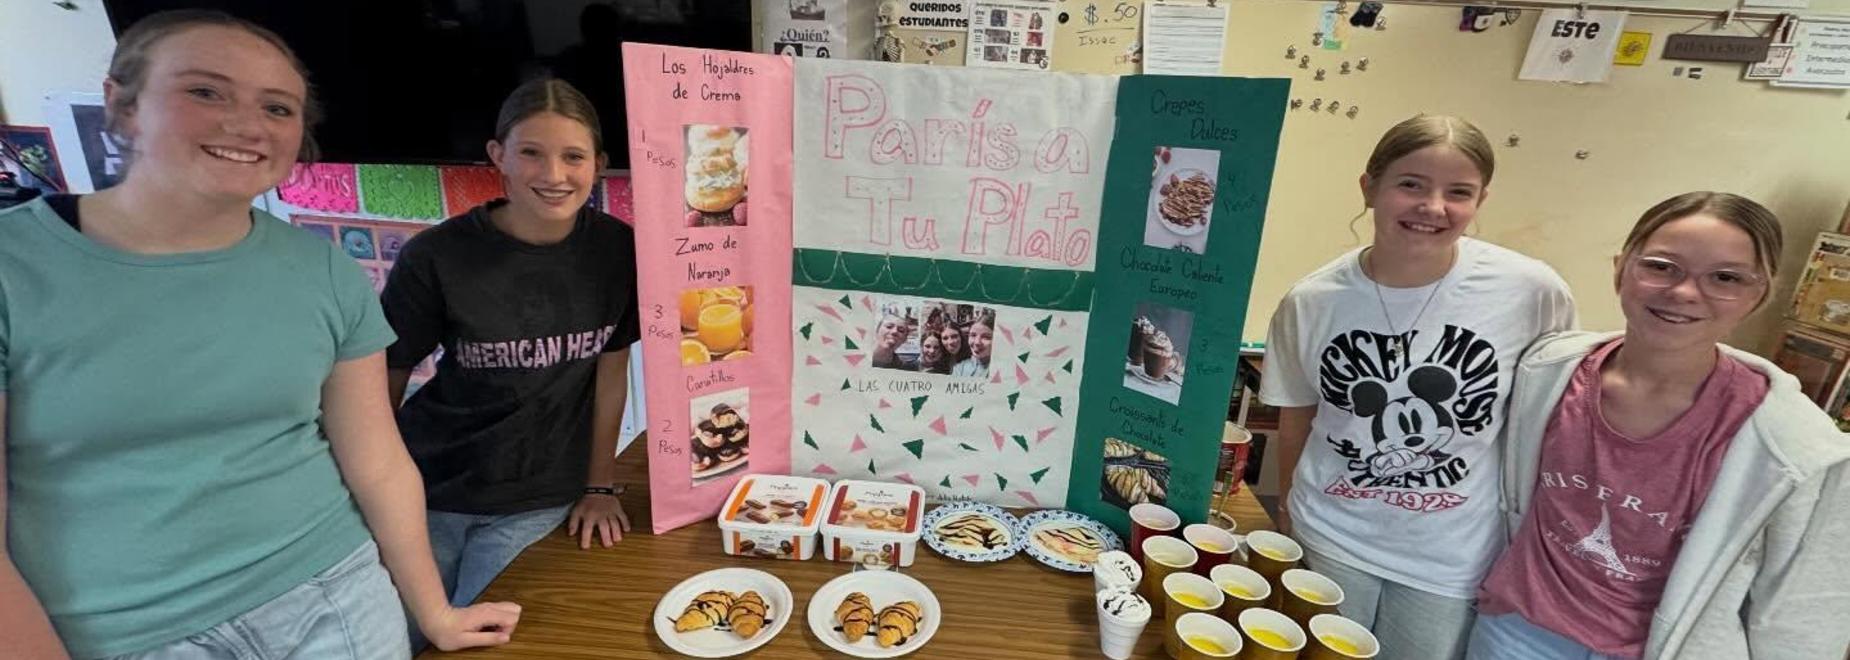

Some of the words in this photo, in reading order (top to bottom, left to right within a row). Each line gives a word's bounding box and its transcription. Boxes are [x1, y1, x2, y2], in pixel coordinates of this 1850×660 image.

[780, 28, 830, 42] ¿Quién?
[662, 53, 687, 75] Los
[703, 55, 755, 80] Hojaldres
[672, 83, 688, 100] de
[700, 84, 742, 101] Crema
[824, 74, 1021, 172] París
[1034, 126, 1090, 174] a
[1190, 117, 1239, 141] Dulces
[846, 175, 940, 251] Tu
[961, 177, 1092, 267] Plato
[674, 237, 714, 256] Zumo
[722, 235, 738, 250] de
[688, 262, 731, 281] Naranja
[655, 304, 664, 319] 3
[456, 335, 562, 369] AMERICAN
[858, 379, 880, 393] LAS
[888, 380, 932, 393] CUATRO
[945, 381, 985, 395] AMIGAS
[1319, 329, 1419, 416] MICKEY
[1422, 324, 1498, 436] MOUSE
[662, 419, 673, 432] 2
[1541, 471, 1588, 489] RIS
